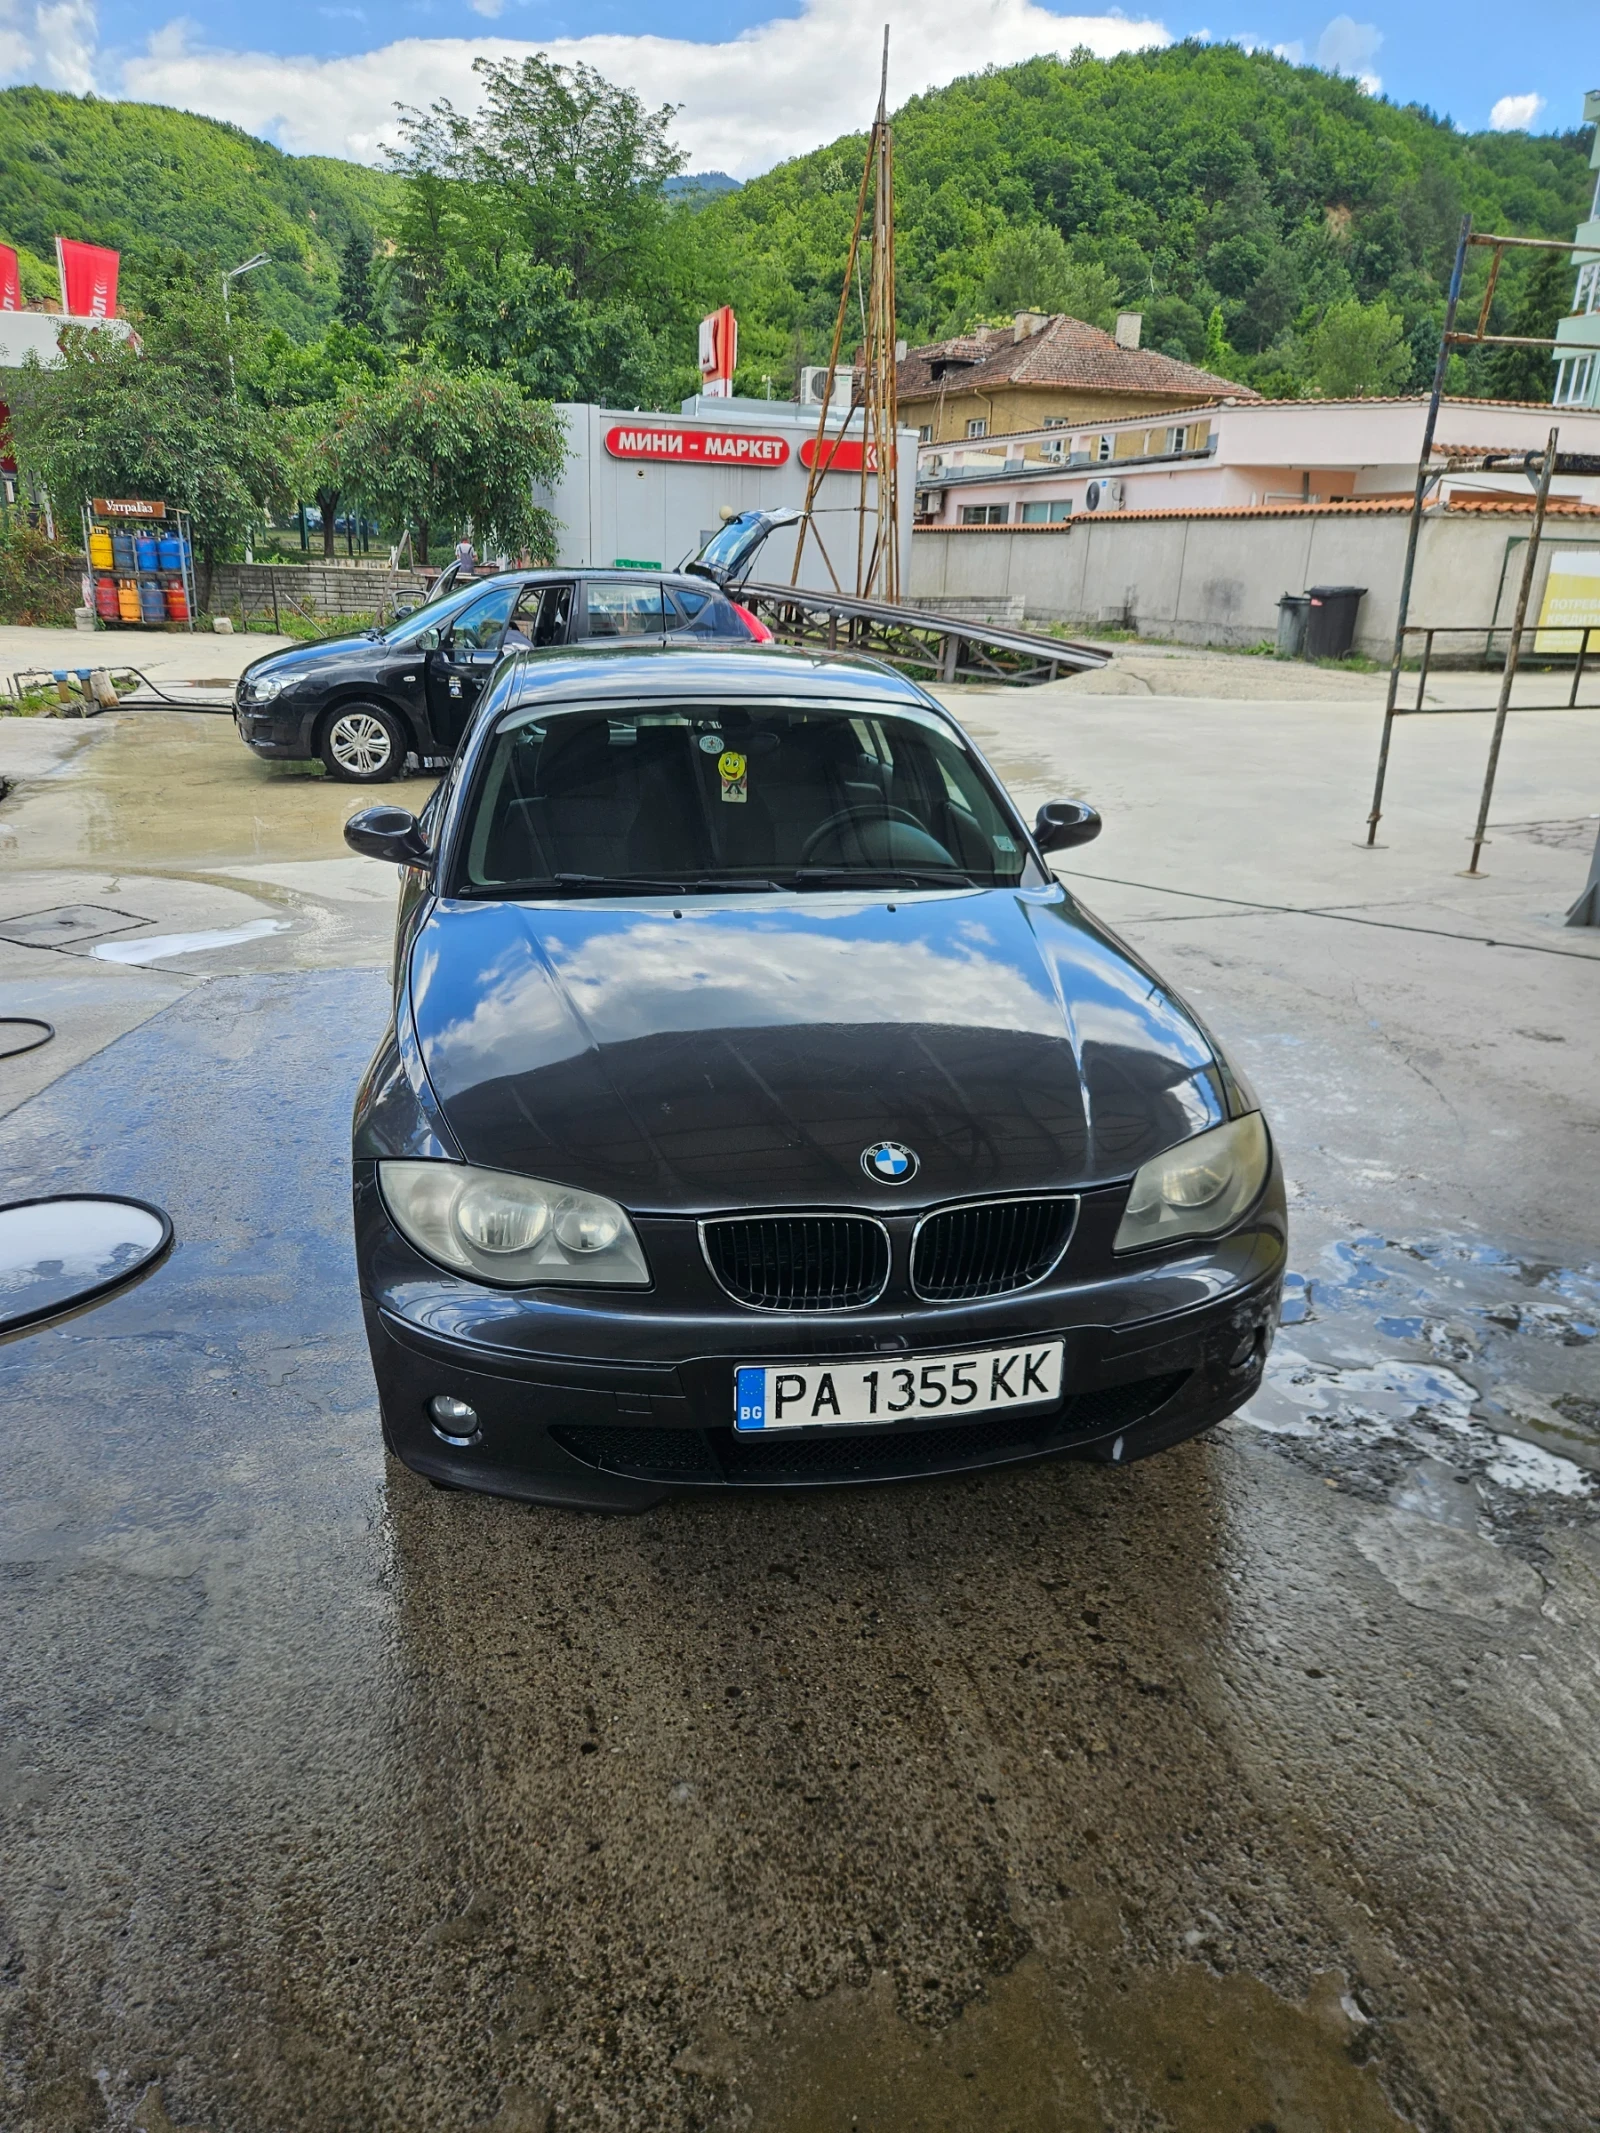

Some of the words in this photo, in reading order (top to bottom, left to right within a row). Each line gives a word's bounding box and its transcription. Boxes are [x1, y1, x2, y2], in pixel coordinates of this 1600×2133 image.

[618, 432, 683, 453] МИНИ
[704, 437, 783, 459] МАРКЕТ
[867, 1142, 911, 1157] BMW
[774, 1372, 841, 1419] PA
[862, 1361, 978, 1414] 1355
[989, 1349, 1051, 1402] KK
[740, 1405, 763, 1421] BG
